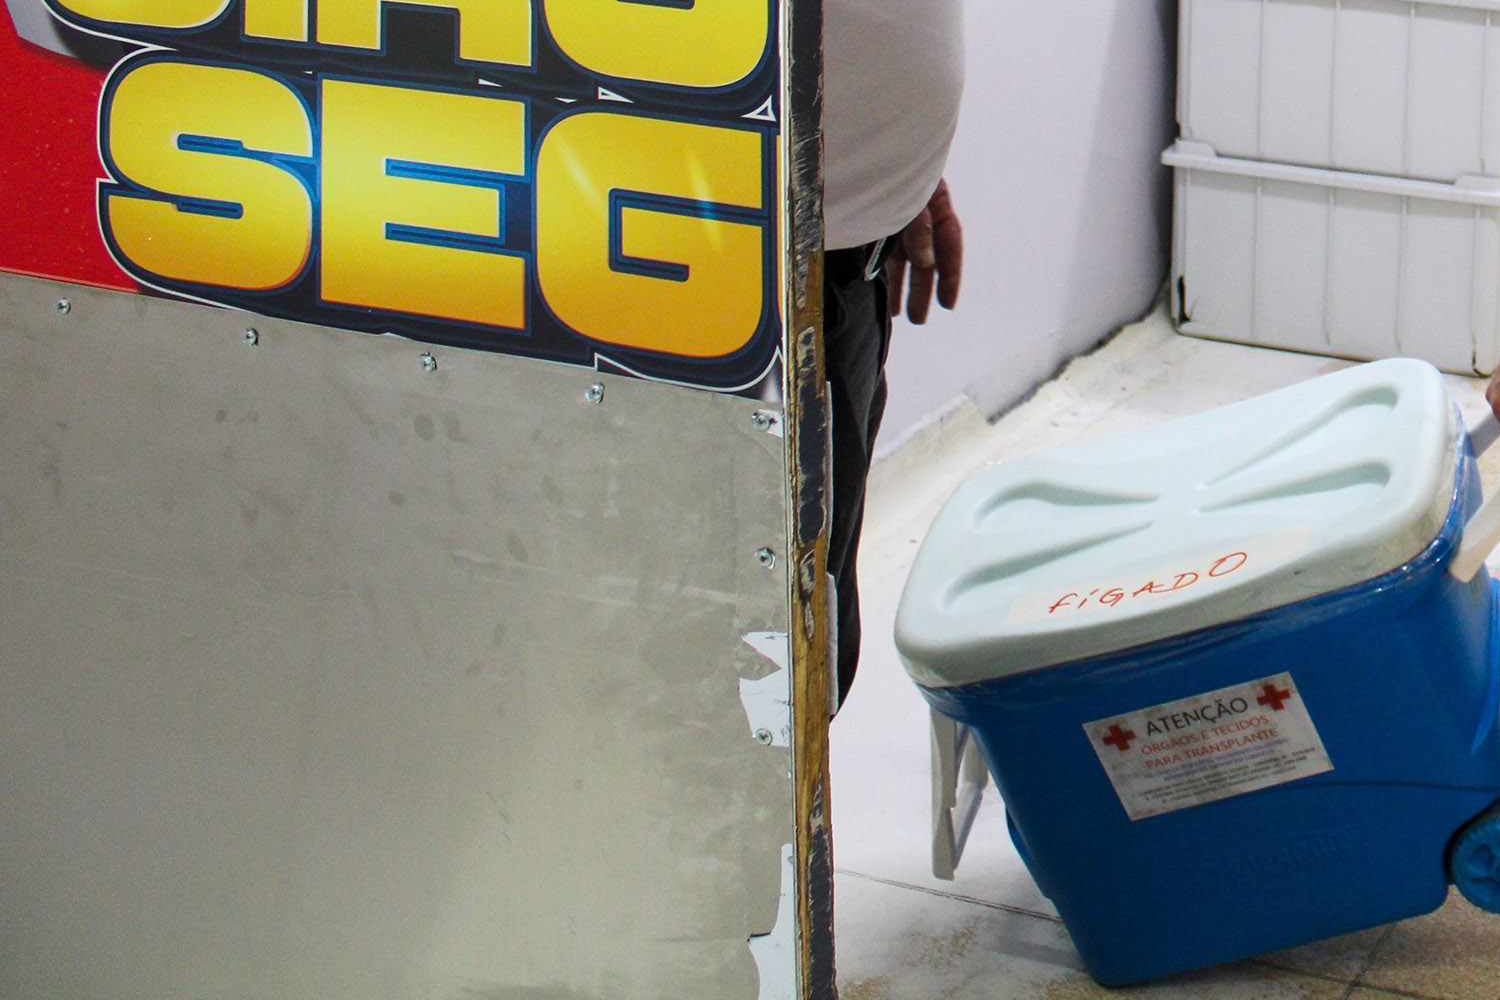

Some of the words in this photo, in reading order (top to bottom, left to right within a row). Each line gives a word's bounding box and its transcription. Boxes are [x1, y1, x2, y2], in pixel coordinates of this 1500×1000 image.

[104, 58, 766, 361] SEG
[1146, 697, 1248, 736] ATENÇÃO
[1201, 727, 1210, 740] E
[1213, 714, 1270, 737] TECIDOS
[1144, 753, 1182, 770] PARA
[1183, 727, 1279, 760] TRANSPLANTE
